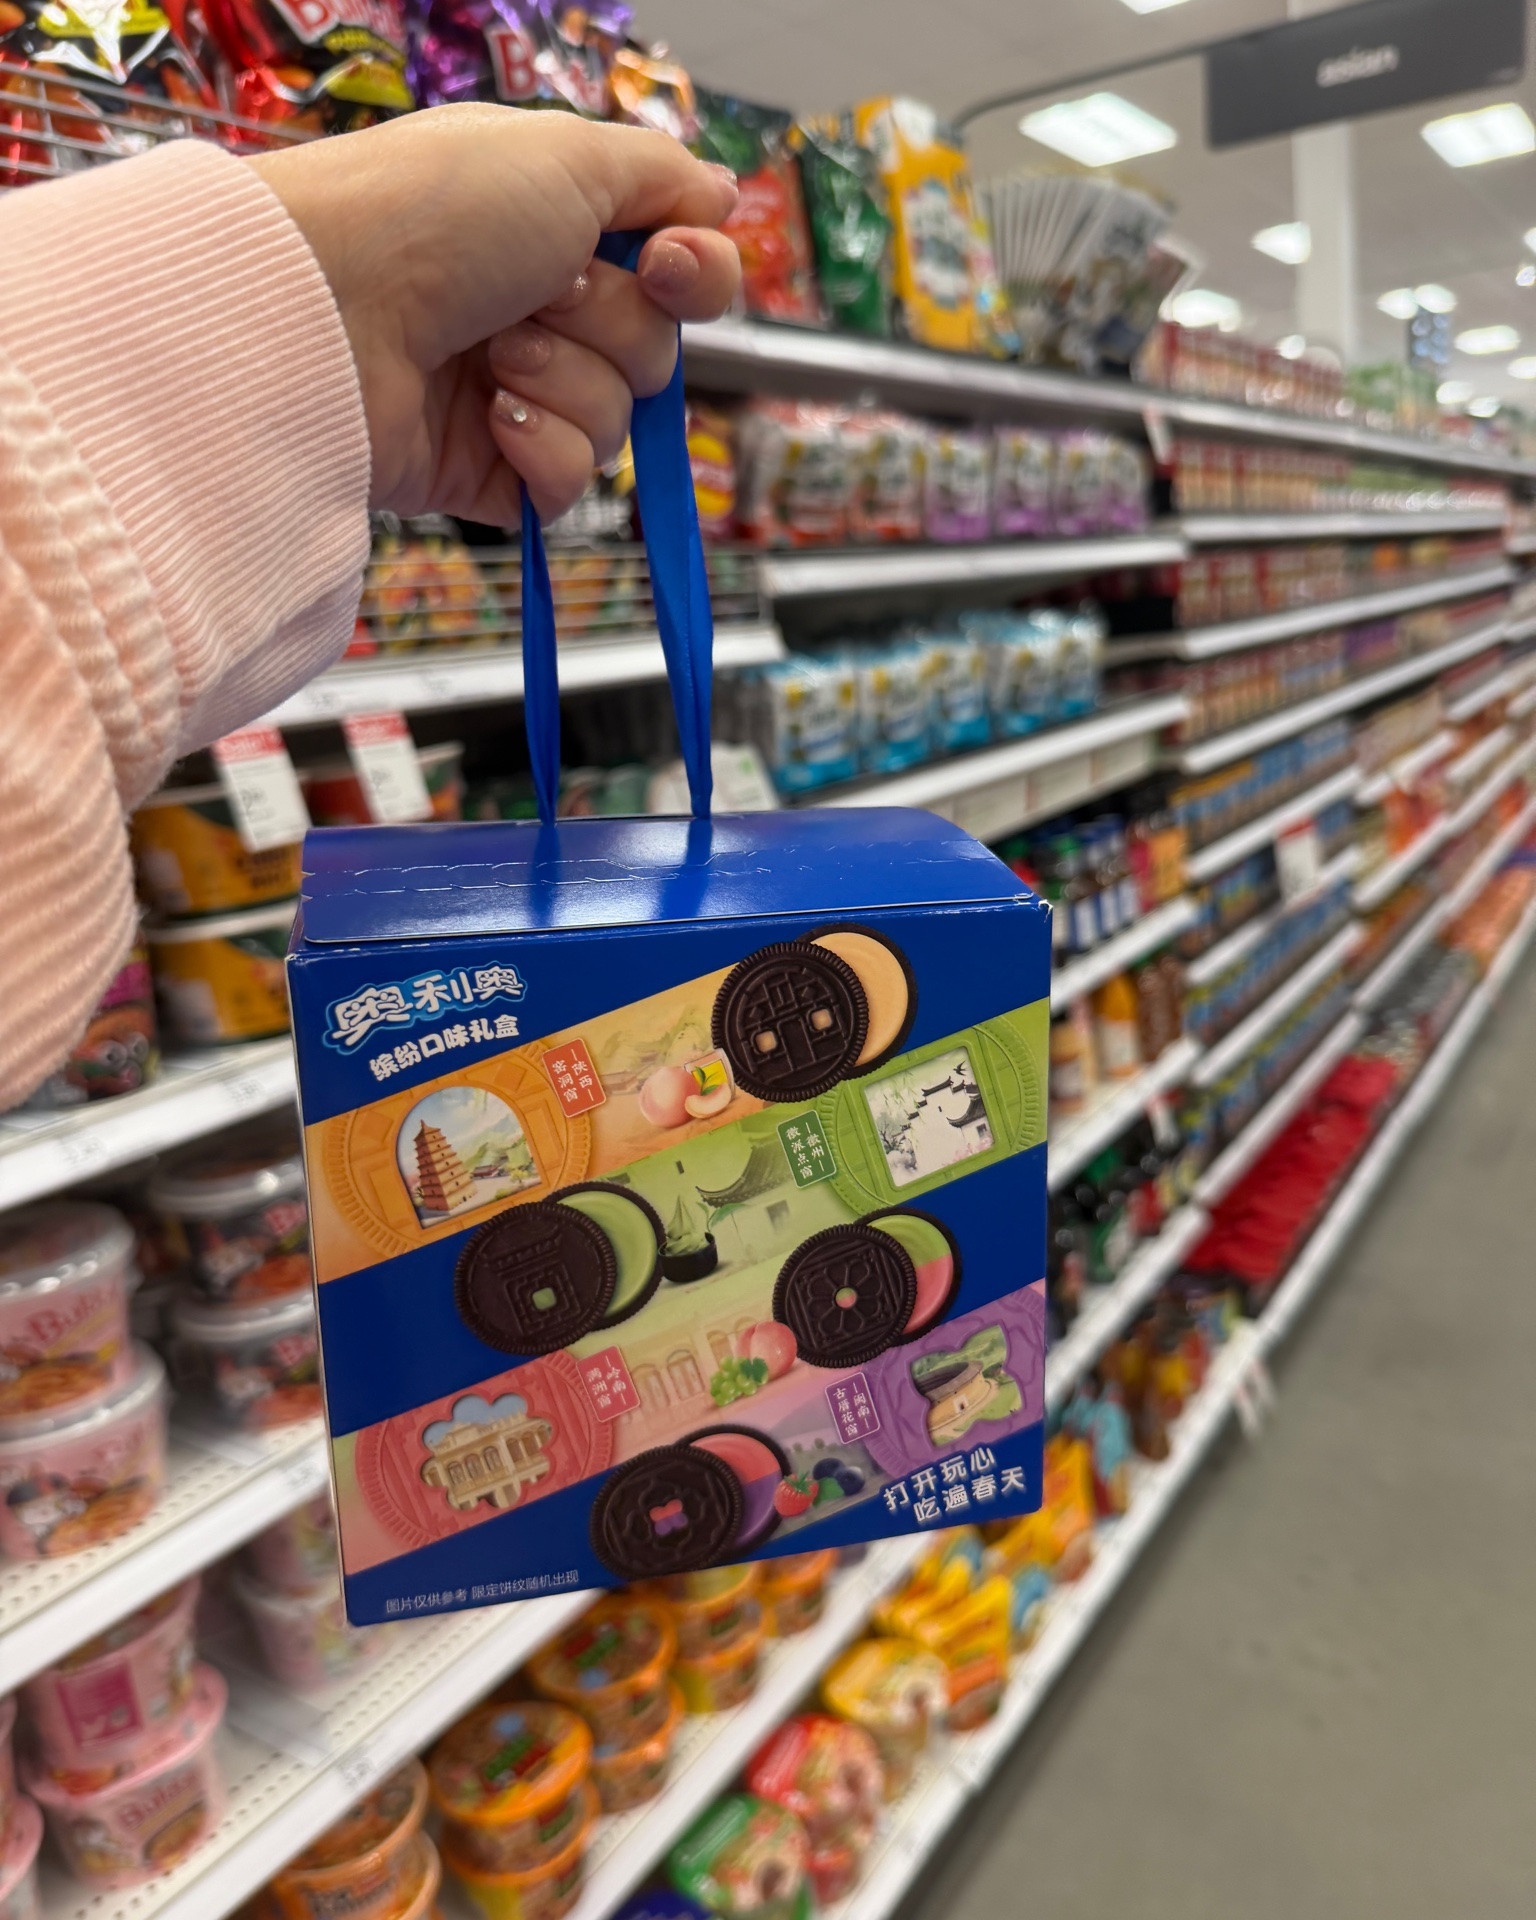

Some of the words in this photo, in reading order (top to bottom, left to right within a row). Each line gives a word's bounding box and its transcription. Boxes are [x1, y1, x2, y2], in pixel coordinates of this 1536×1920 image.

[332, 966, 524, 1046] 奥利奥
[369, 1014, 520, 1081] 缤纷口味礼盒
[552, 1060, 578, 1102] 窑洞窗
[883, 1447, 995, 1511] 打开玩心
[913, 1466, 1024, 1522] 吃遍春天
[386, 1588, 468, 1613] 图片仅供参考
[471, 1570, 579, 1600] 限定饼纹随机出现
